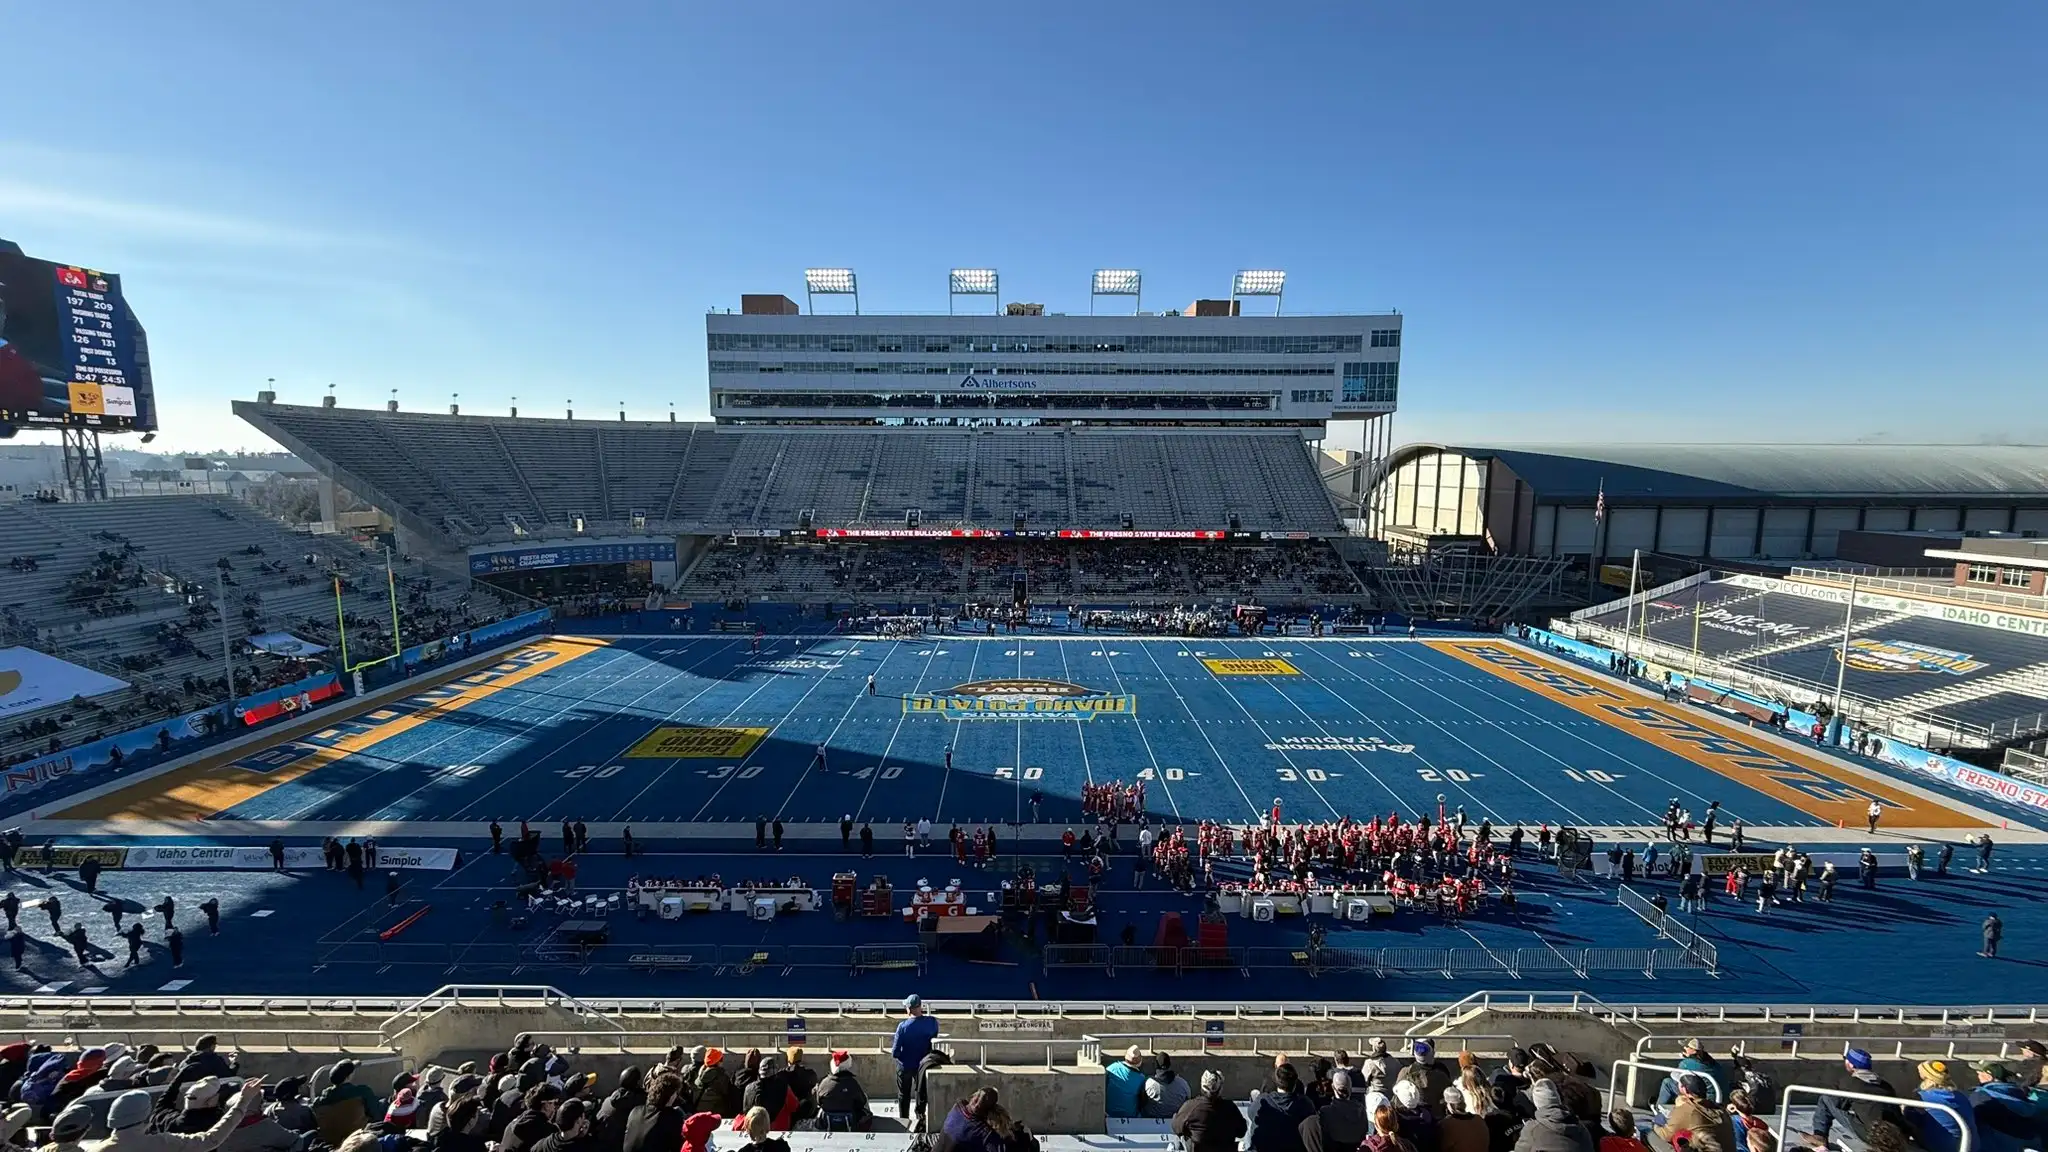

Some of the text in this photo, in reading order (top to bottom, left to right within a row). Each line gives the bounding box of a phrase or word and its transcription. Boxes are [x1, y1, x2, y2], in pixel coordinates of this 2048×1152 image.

[66, 297, 113, 311] 197 209
[72, 316, 113, 329] 71 78
[72, 335, 116, 348] 126 131
[80, 354, 117, 366] 9 13
[75, 372, 126, 384] 8:47 24:51
[981, 379, 1037, 388] Albertsons
[519, 558, 555, 567] CHAMPIONS
[1780, 582, 1837, 600] ICCU.com
[912, 698, 1127, 712] IDAHO POTATO
[660, 736, 741, 746] IDAHO
[1264, 743, 1378, 752] Albertsons
[5, 755, 74, 792] NIU
[563, 765, 625, 779] 20
[706, 766, 765, 778] 30
[849, 766, 904, 780] 40
[993, 766, 1044, 780] 50
[1136, 767, 1184, 781] 40
[1275, 768, 1327, 781] 30
[1416, 768, 1472, 782] 20
[1561, 768, 1617, 783] 10
[1956, 767, 2020, 797] FRESNO
[156, 848, 186, 859] Idaho
[190, 847, 234, 859] Central
[380, 856, 422, 868] Simplot
[1707, 856, 1758, 865] FAMOUS
[917, 906, 929, 916] G
[948, 906, 958, 916] G
[823, 1132, 833, 1140] 21
[865, 1132, 876, 1140] 20
